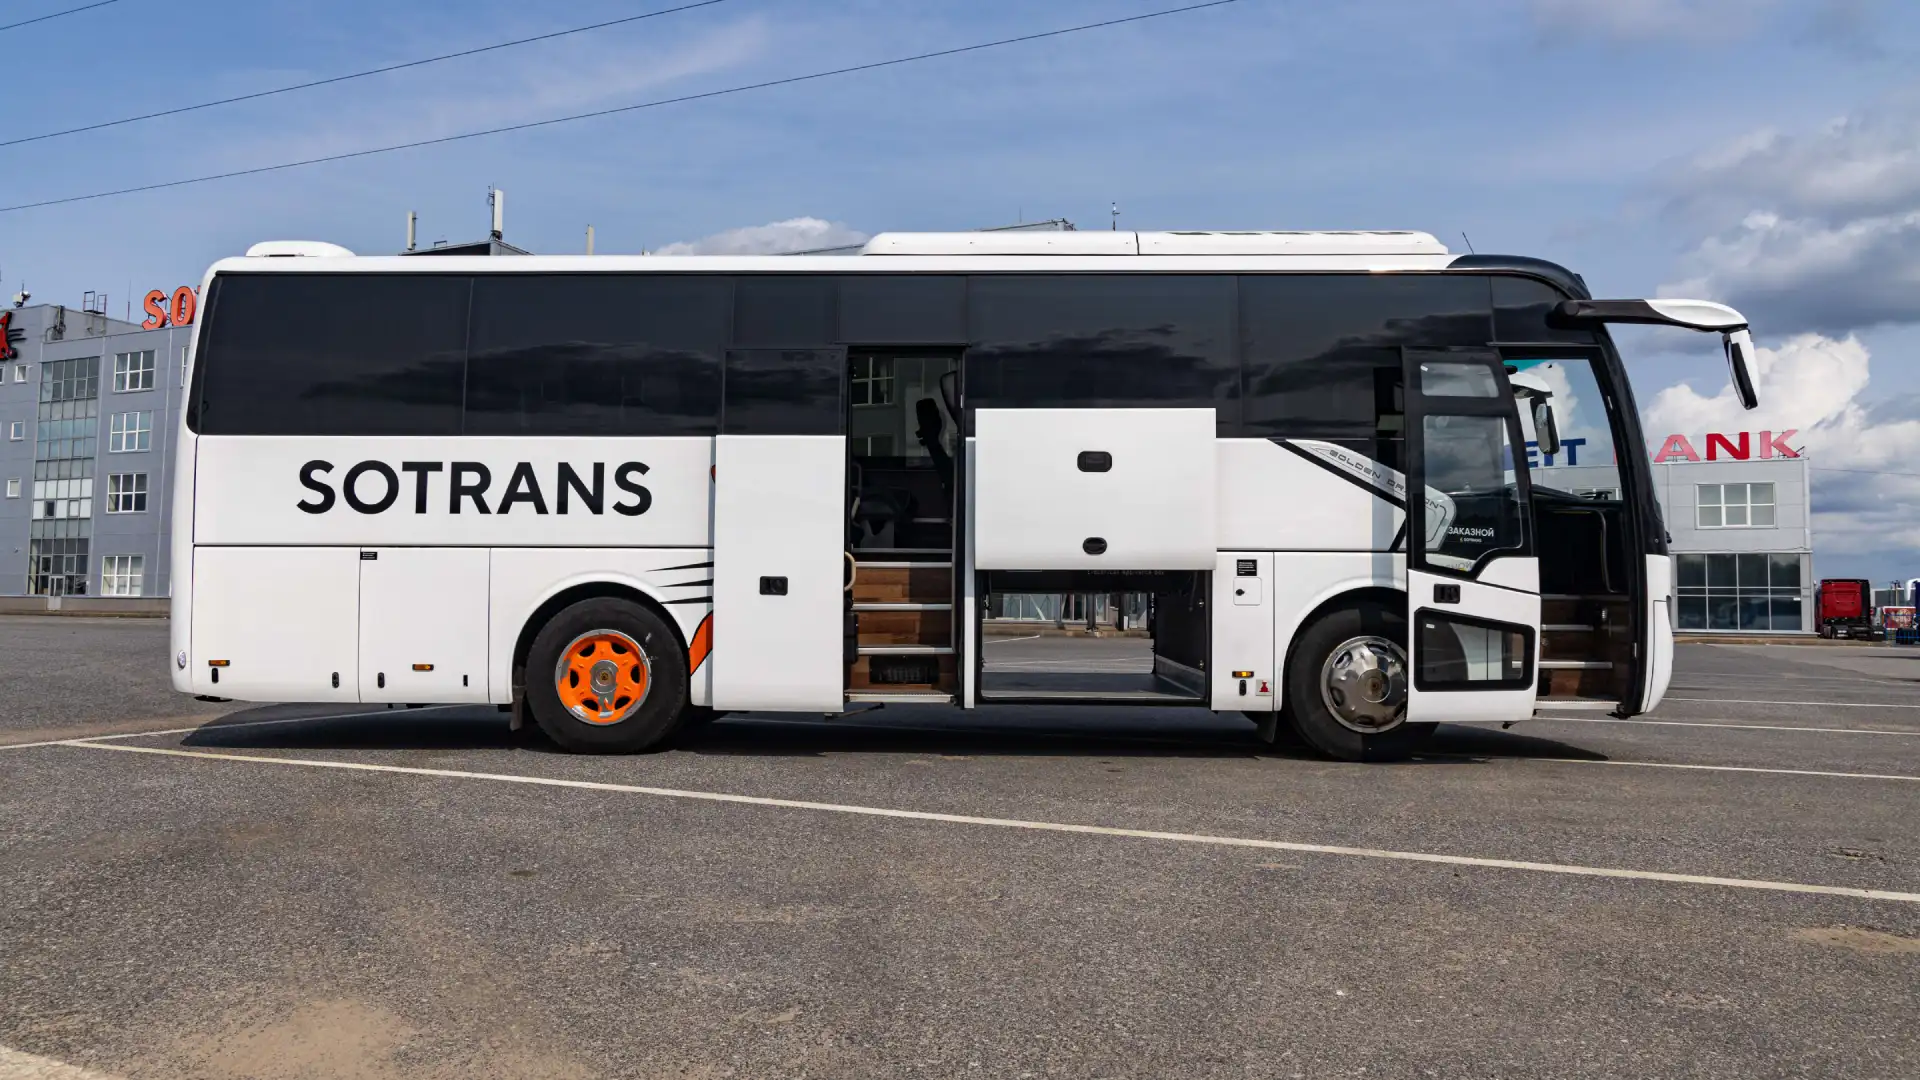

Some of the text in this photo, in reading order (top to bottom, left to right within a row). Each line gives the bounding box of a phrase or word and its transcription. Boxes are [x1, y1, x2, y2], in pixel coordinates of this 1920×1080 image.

[1613, 429, 1800, 464] ANK
[1329, 449, 1381, 479] GOLDEN
[296, 459, 653, 516] SOTRANS
[1448, 526, 1494, 537] ЗАКАЗНОЙ
